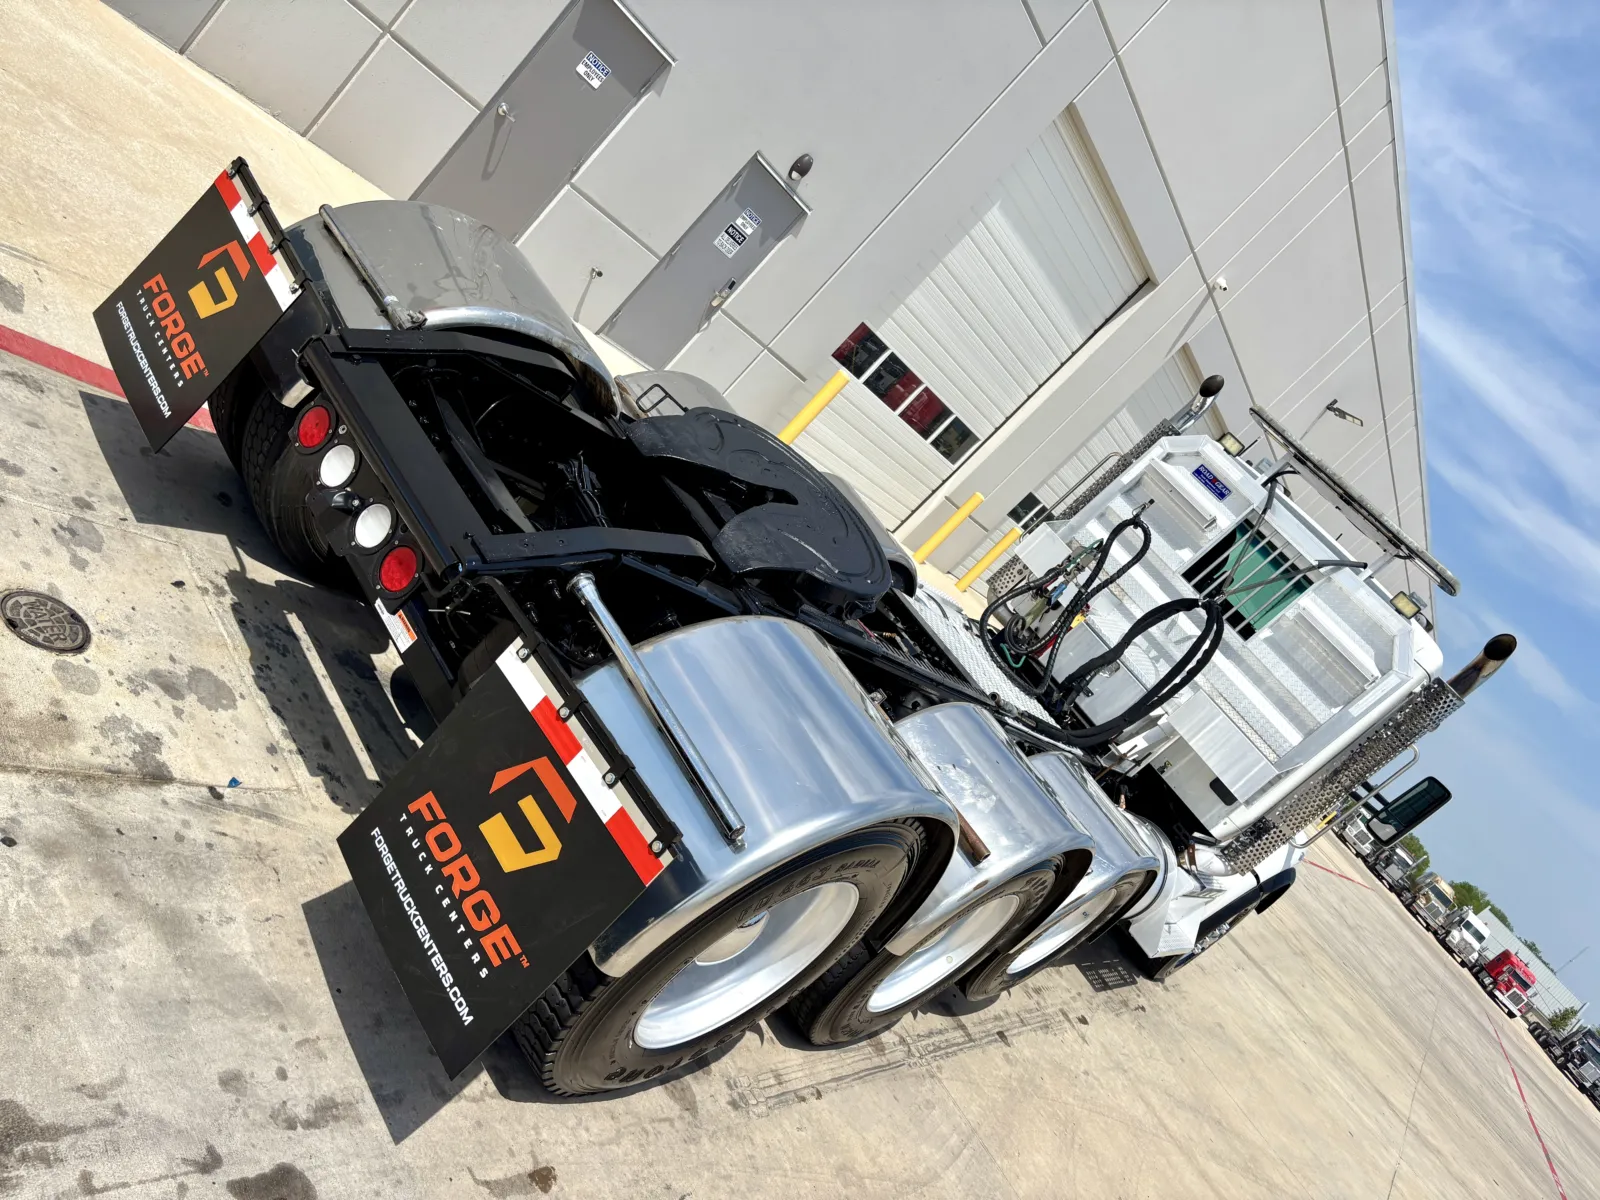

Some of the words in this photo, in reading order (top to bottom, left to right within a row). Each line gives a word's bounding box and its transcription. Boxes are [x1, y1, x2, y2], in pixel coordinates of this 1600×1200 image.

[581, 59, 604, 82] EMPLOYEES
[583, 70, 595, 81] ONLY
[587, 53, 609, 76] NOTICE
[727, 226, 745, 243] NOTICE
[745, 209, 760, 225] NOTICE
[136, 289, 155, 327] TRUCK
[154, 331, 184, 388] CENTERS
[143, 273, 206, 380] FORGE
[115, 301, 172, 419] FORGETRUCKCENTERS.COM
[1198, 466, 1213, 480] ROAD
[1214, 481, 1230, 495] GEAR
[399, 813, 434, 875] TRUCK
[435, 884, 489, 979] CENTERS
[407, 790, 522, 968] FORGE
[370, 826, 475, 1027] FORGETRUCKCENTERS.COM
